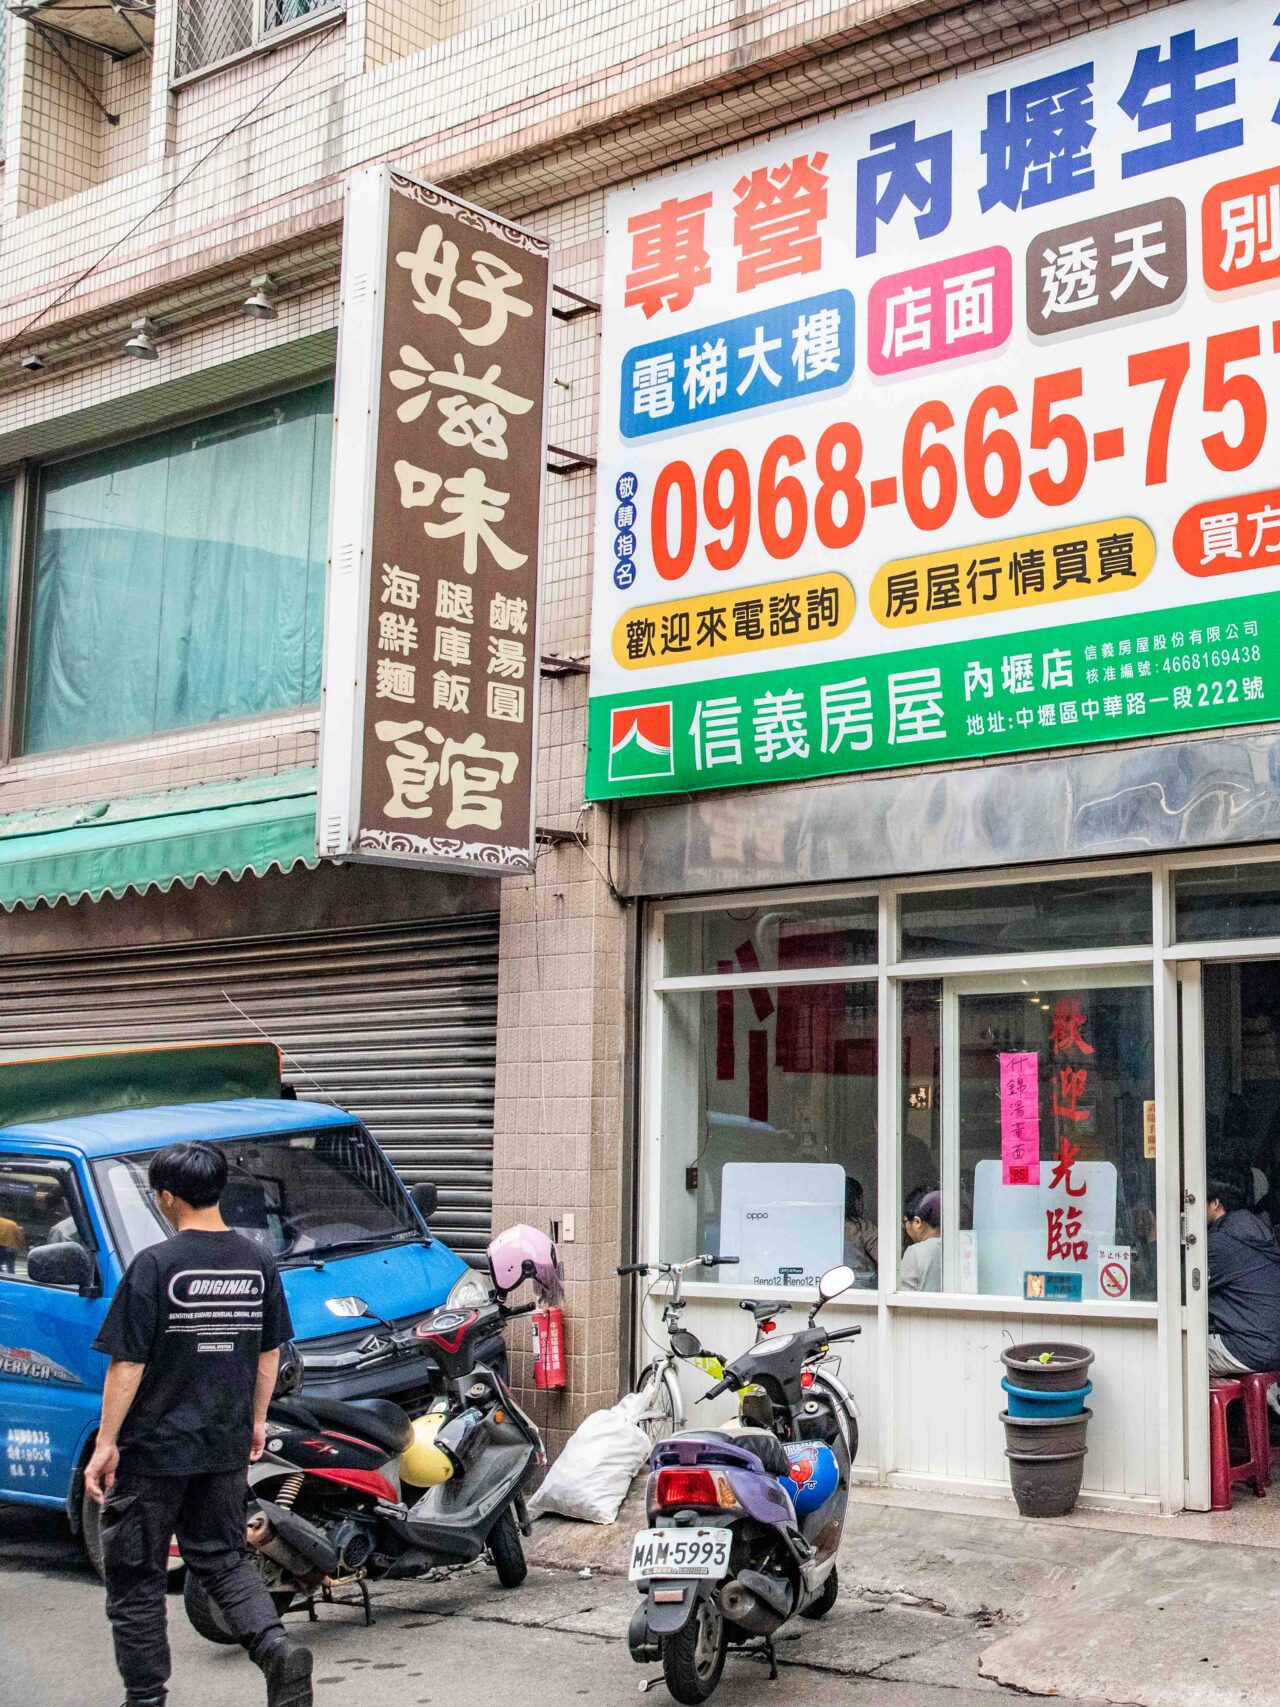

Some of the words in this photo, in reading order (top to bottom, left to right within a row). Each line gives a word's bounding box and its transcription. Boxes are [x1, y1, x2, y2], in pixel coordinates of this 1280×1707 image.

[881, 265, 997, 359] 店面
[1040, 219, 1170, 319] 透天
[631, 308, 842, 420] 電梯大樓
[614, 475, 638, 587] 敬請指名
[885, 532, 1138, 618] 房屋行情買賣
[376, 563, 420, 705] 海鮮麵
[432, 578, 474, 716] 腿庫飯
[486, 591, 528, 724] 鹹湯圓
[626, 586, 840, 661] 歡迎來電諮詢
[1084, 620, 1259, 662] 信義房屋股份有限公司
[687, 666, 947, 771] 信義房屋
[964, 648, 1075, 702] 內壢店
[1046, 995, 1096, 1264] 歡迎光臨
[188, 1279, 254, 1295] ORIGINAL
[632, 1541, 728, 1570] MAM-5993
